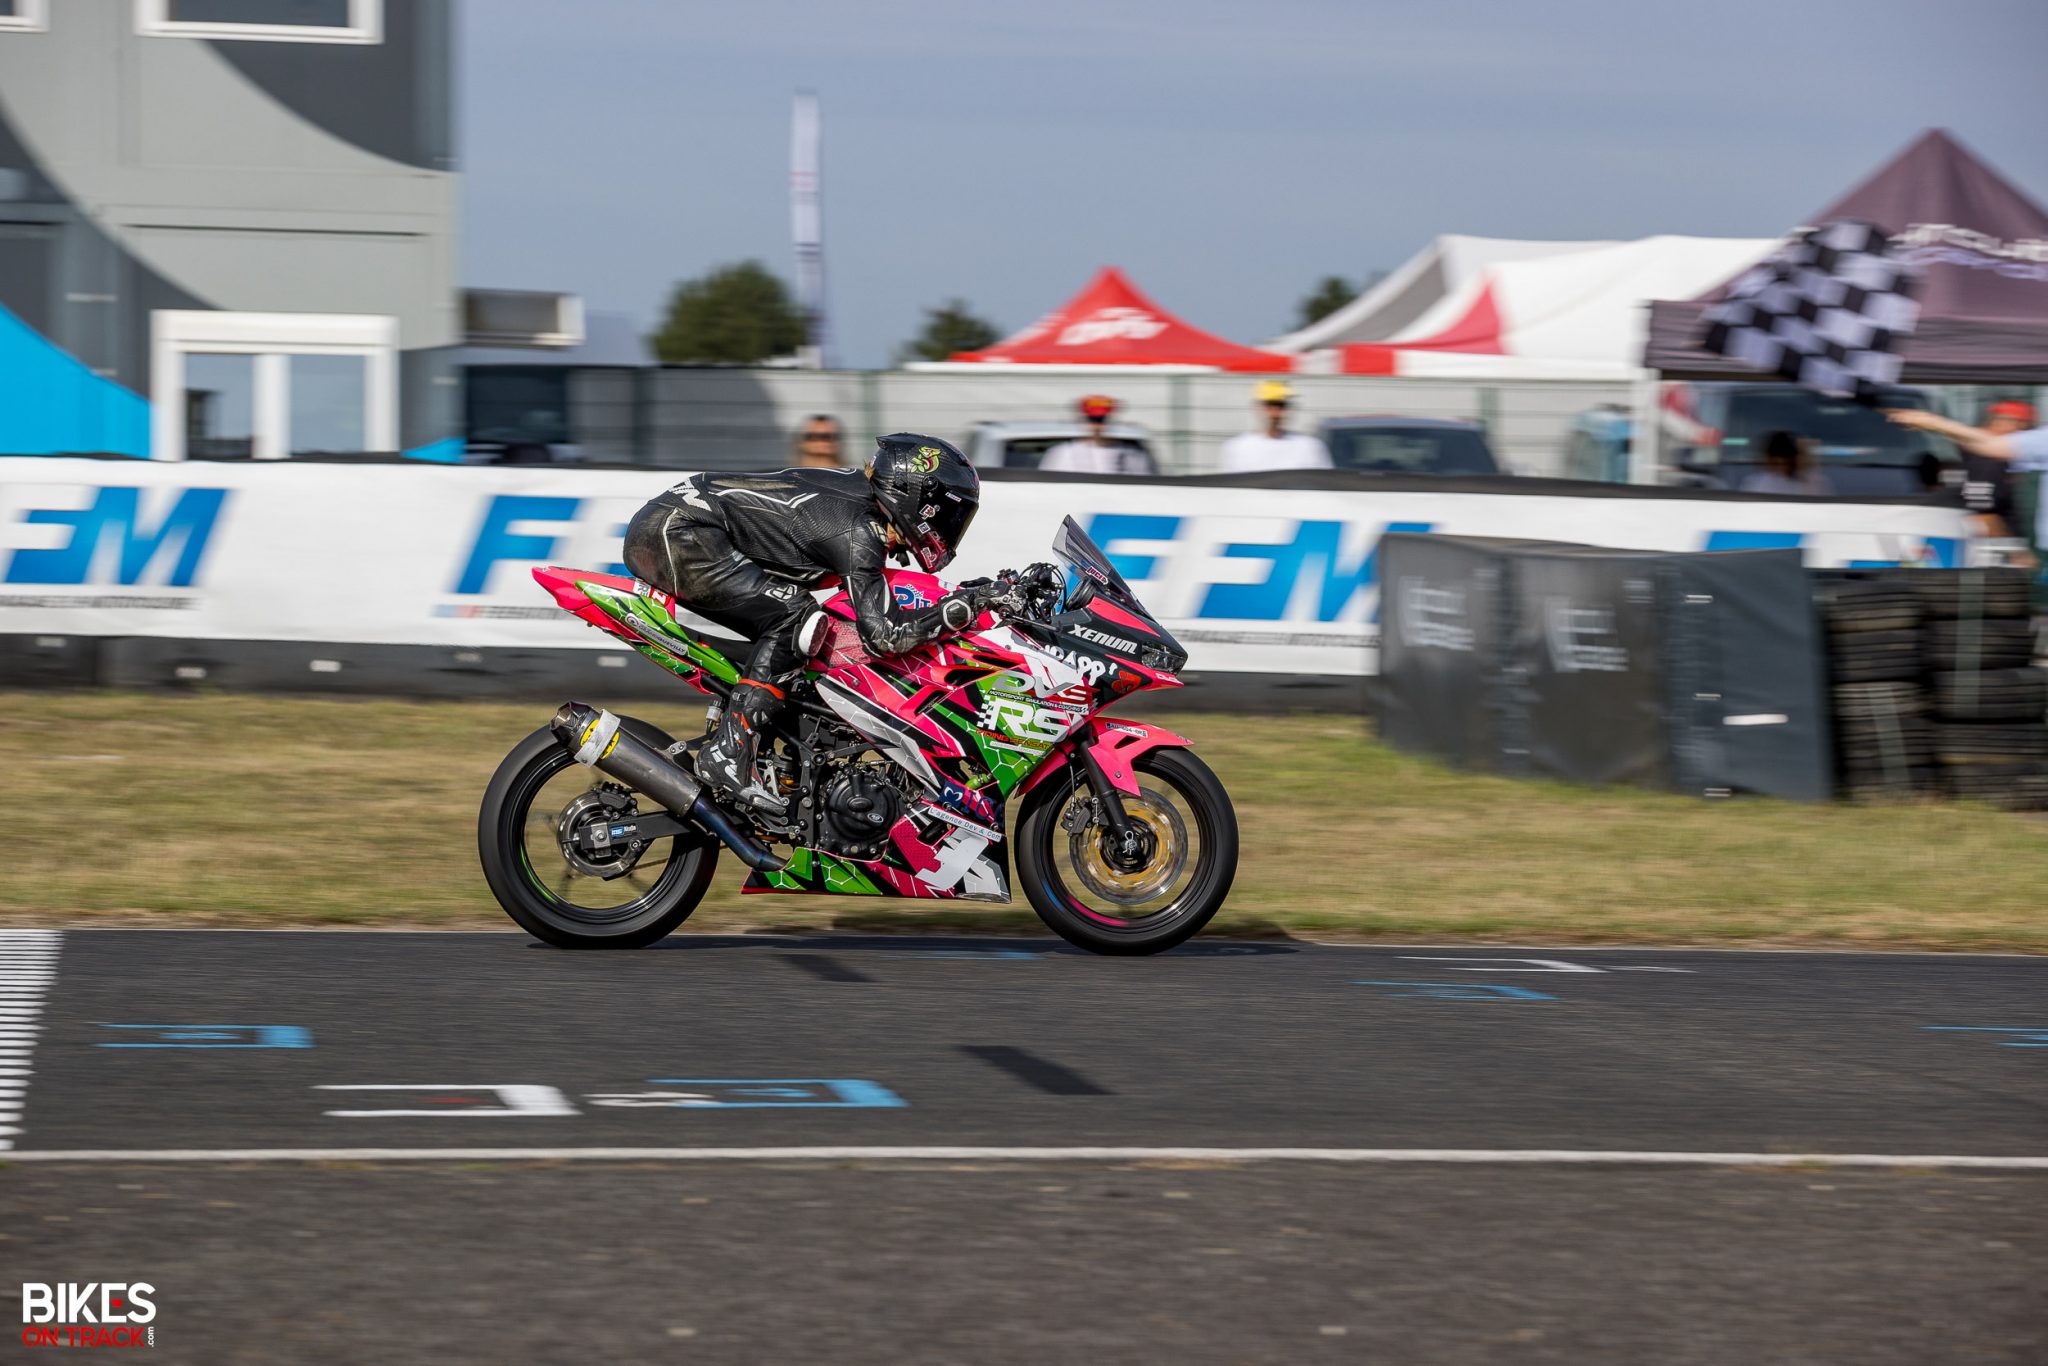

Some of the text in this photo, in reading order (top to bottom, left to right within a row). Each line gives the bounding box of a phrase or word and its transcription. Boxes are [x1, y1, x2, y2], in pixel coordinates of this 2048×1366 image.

[1067, 623, 1138, 655] XENUM
[930, 806, 963, 826] L'agence
[964, 821, 978, 832] Dev
